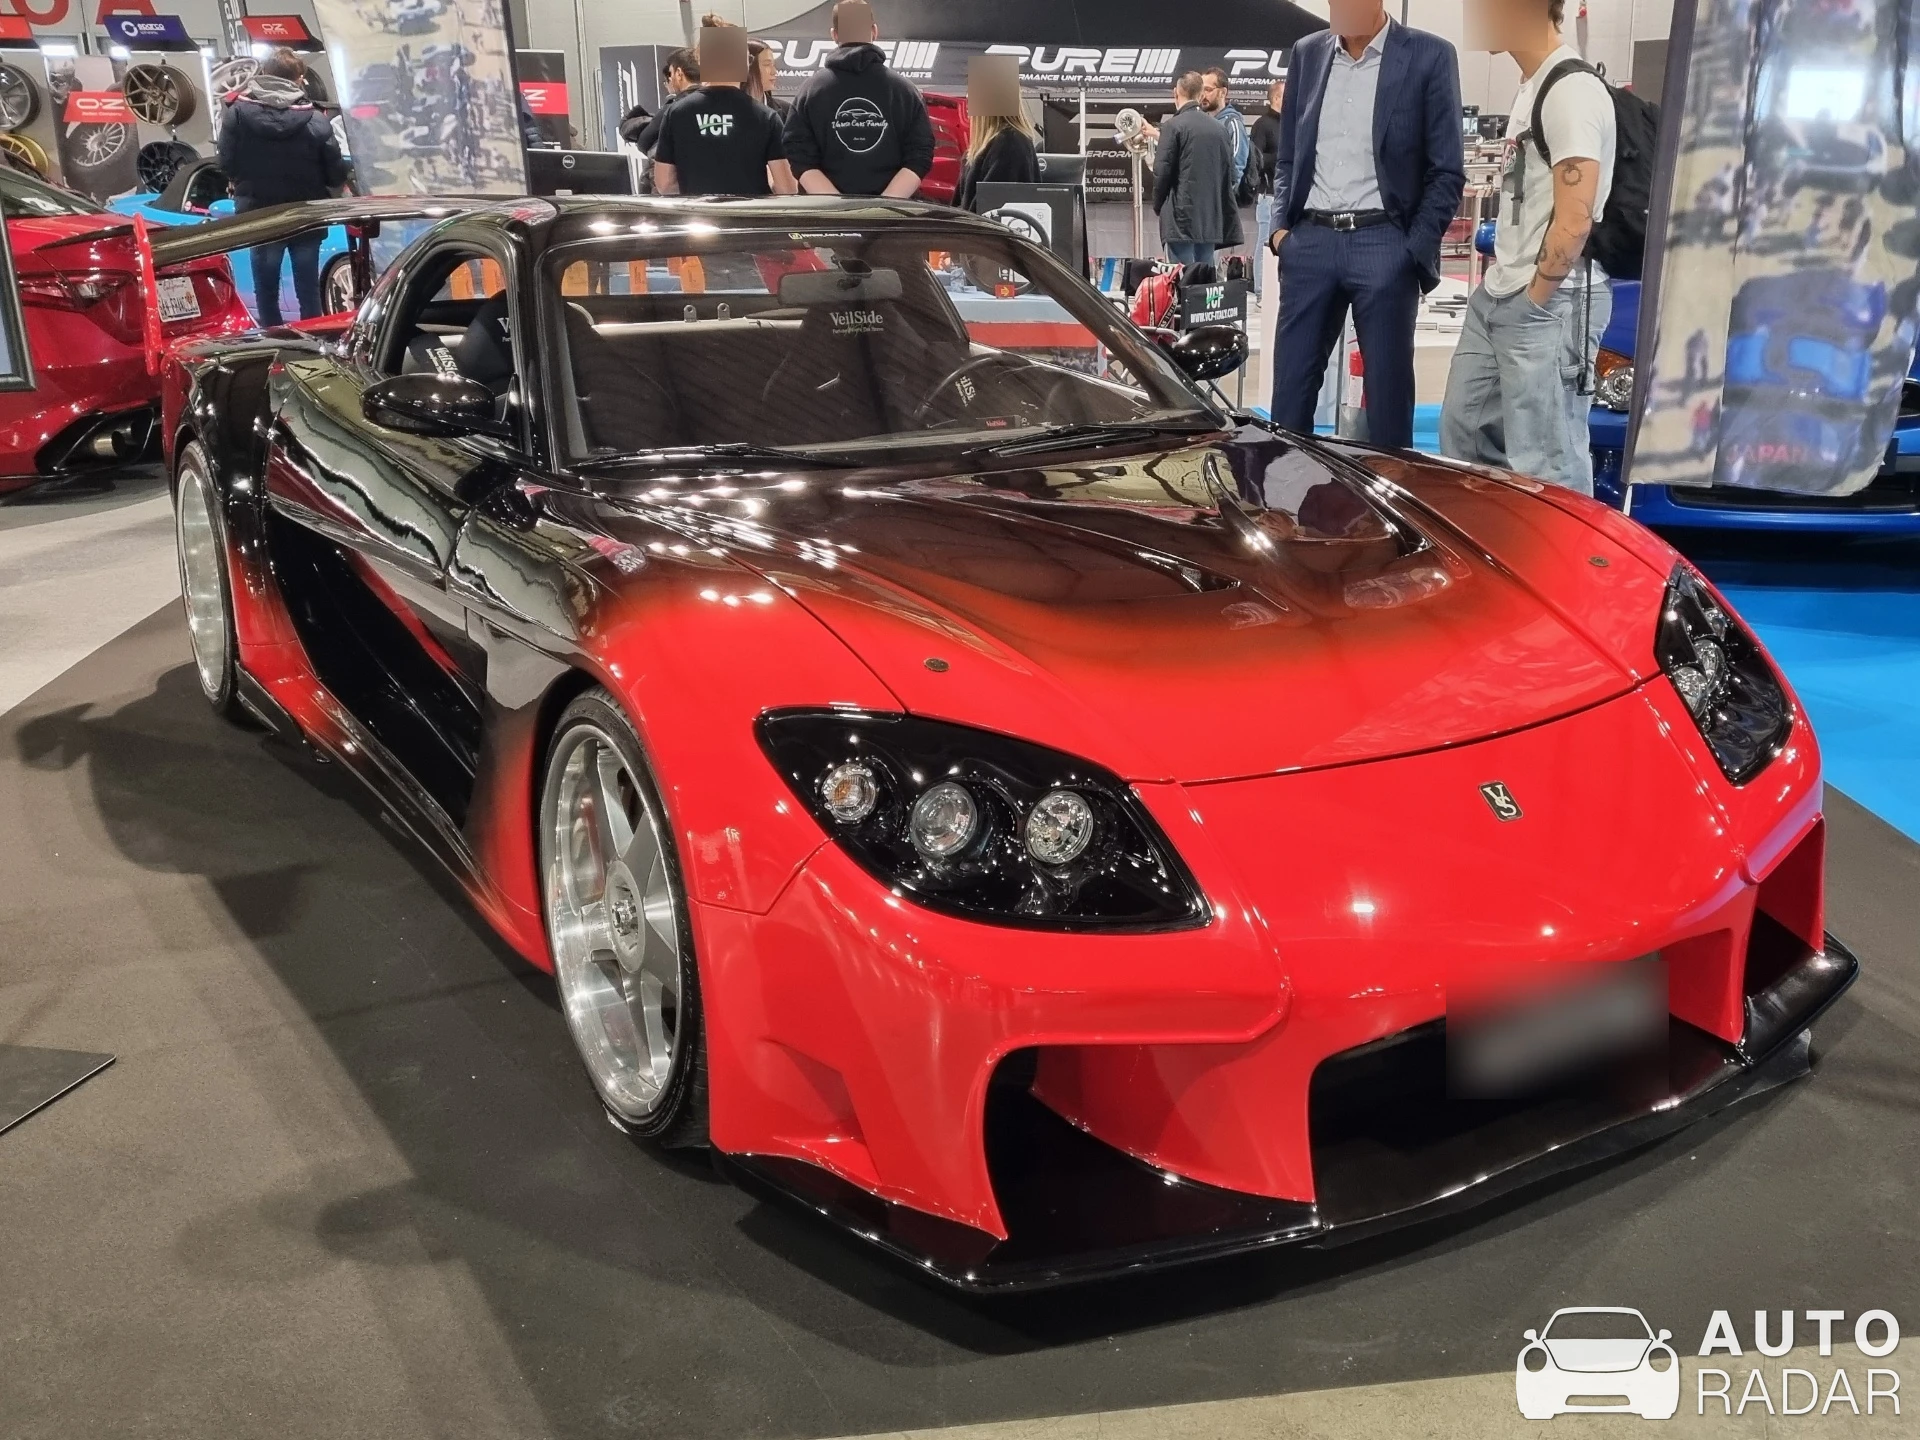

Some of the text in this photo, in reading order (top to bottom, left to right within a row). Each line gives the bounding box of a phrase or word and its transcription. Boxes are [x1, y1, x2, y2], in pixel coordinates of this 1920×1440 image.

[1018, 73, 1173, 84] RMANCE UNIT RACING EXHAUSTS
[696, 113, 733, 136] VCF
[1205, 285, 1225, 310] VCF
[829, 310, 884, 326] VeilSide
